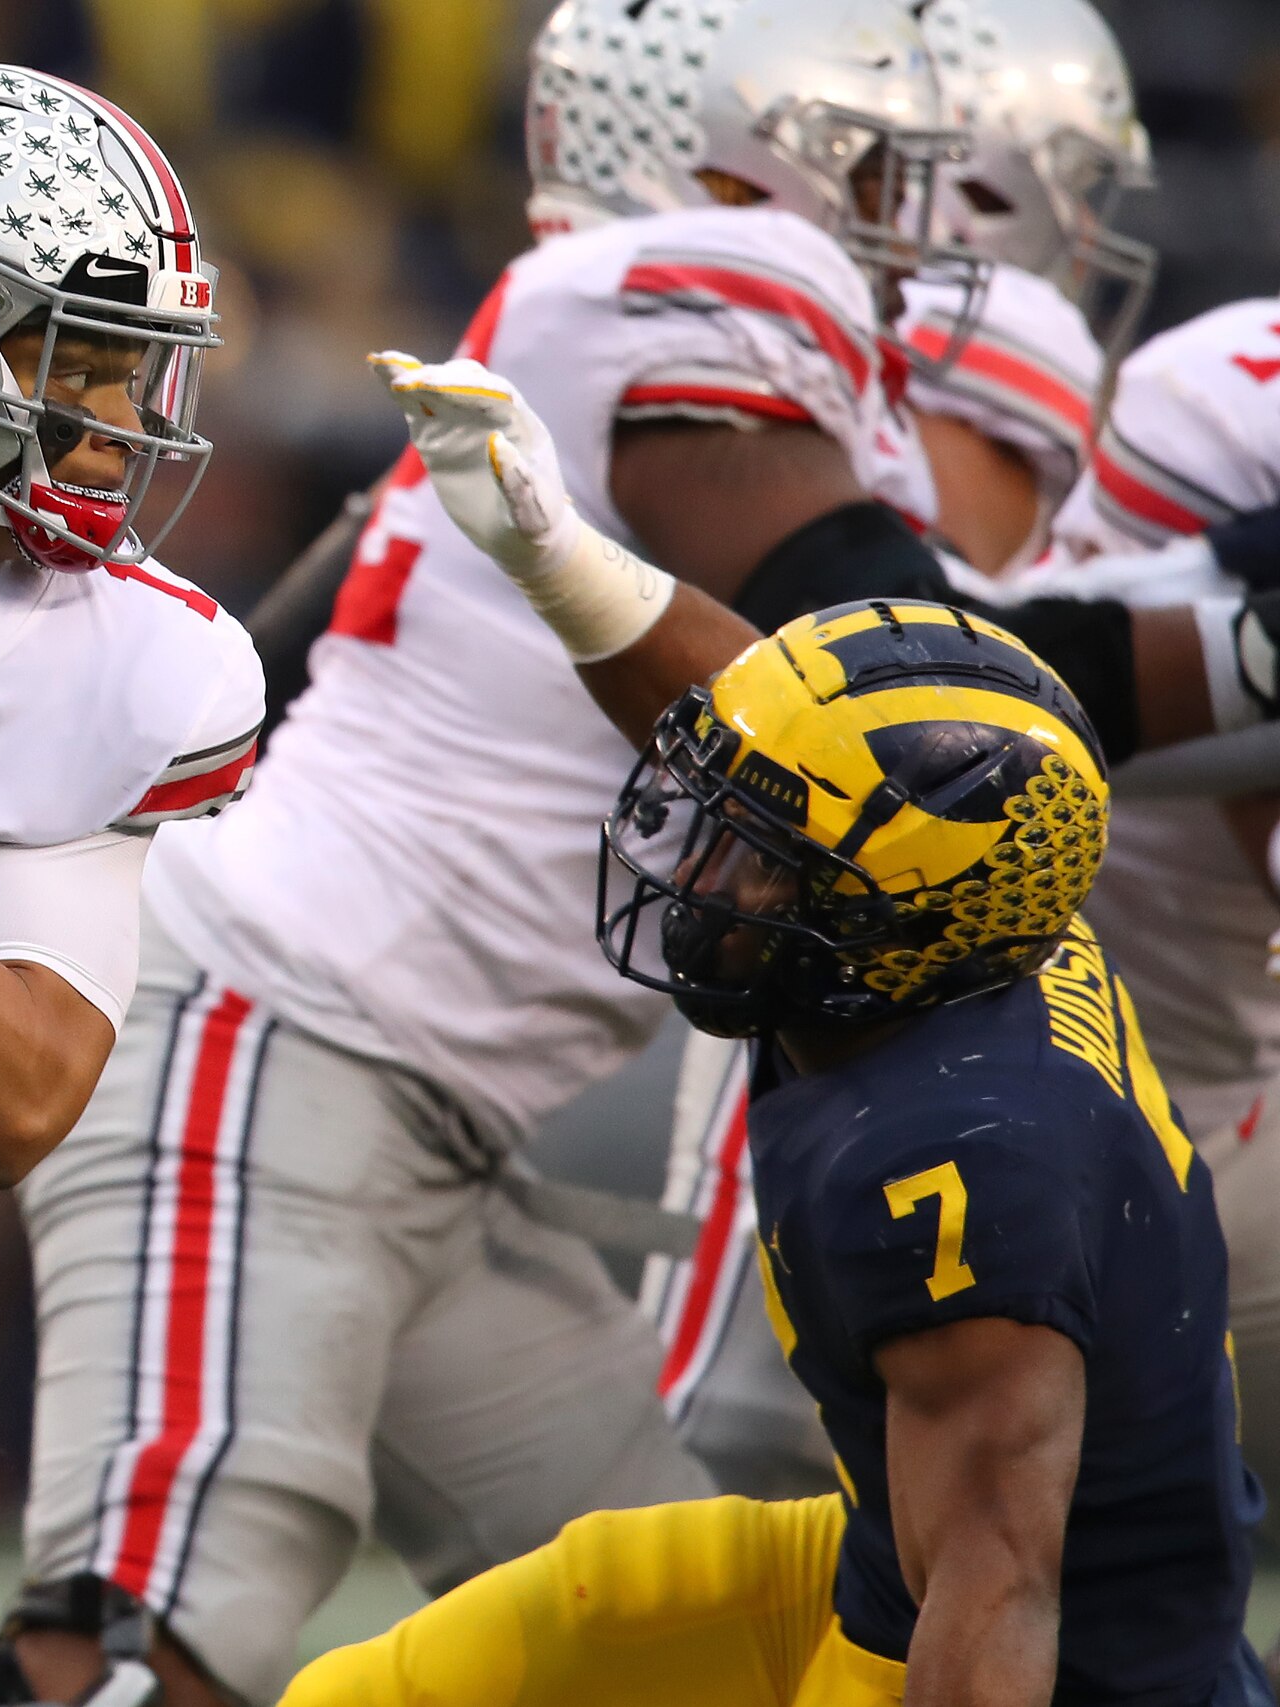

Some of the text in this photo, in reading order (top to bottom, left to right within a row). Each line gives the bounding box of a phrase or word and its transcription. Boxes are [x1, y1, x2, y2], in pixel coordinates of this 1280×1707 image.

[104, 562, 218, 622] 1
[740, 767, 804, 808] JORDAN
[882, 1160, 977, 1302] 7
